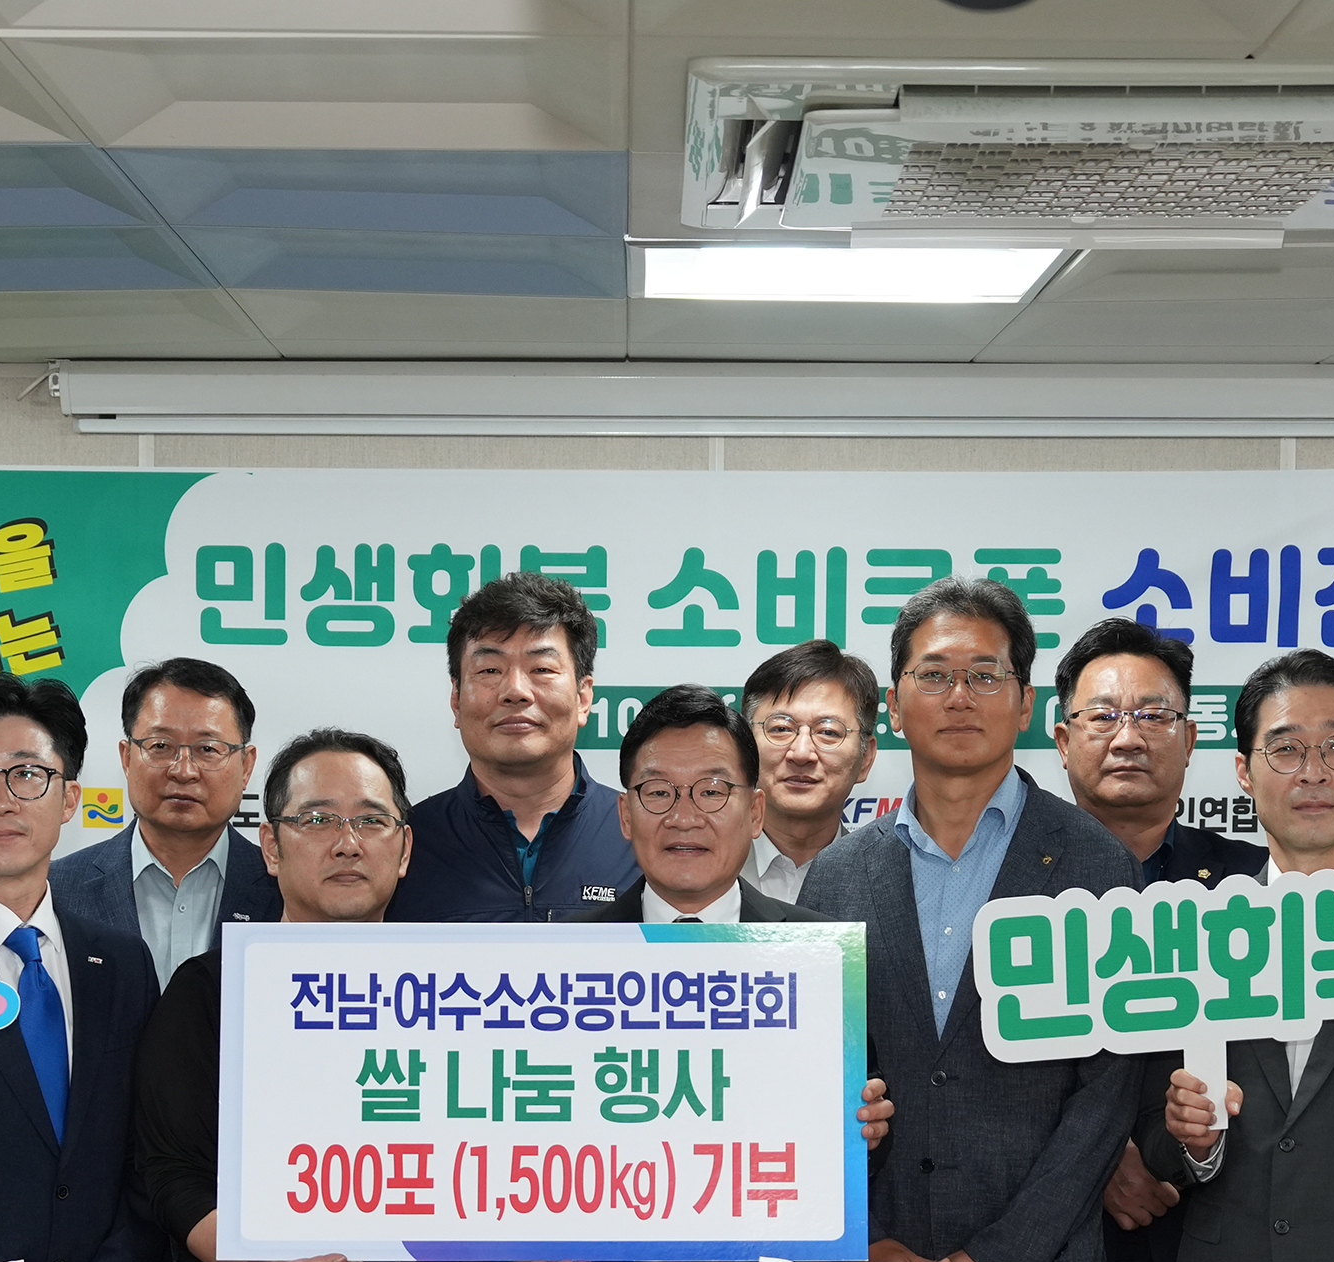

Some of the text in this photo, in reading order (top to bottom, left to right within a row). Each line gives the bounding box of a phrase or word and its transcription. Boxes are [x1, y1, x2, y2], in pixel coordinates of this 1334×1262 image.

[840, 797, 904, 824] KFM
[582, 885, 616, 898] KFME
[355, 1045, 731, 1124] 쌀 나눔 행사
[286, 1142, 436, 1217] 300포
[692, 1140, 799, 1220] 기부
